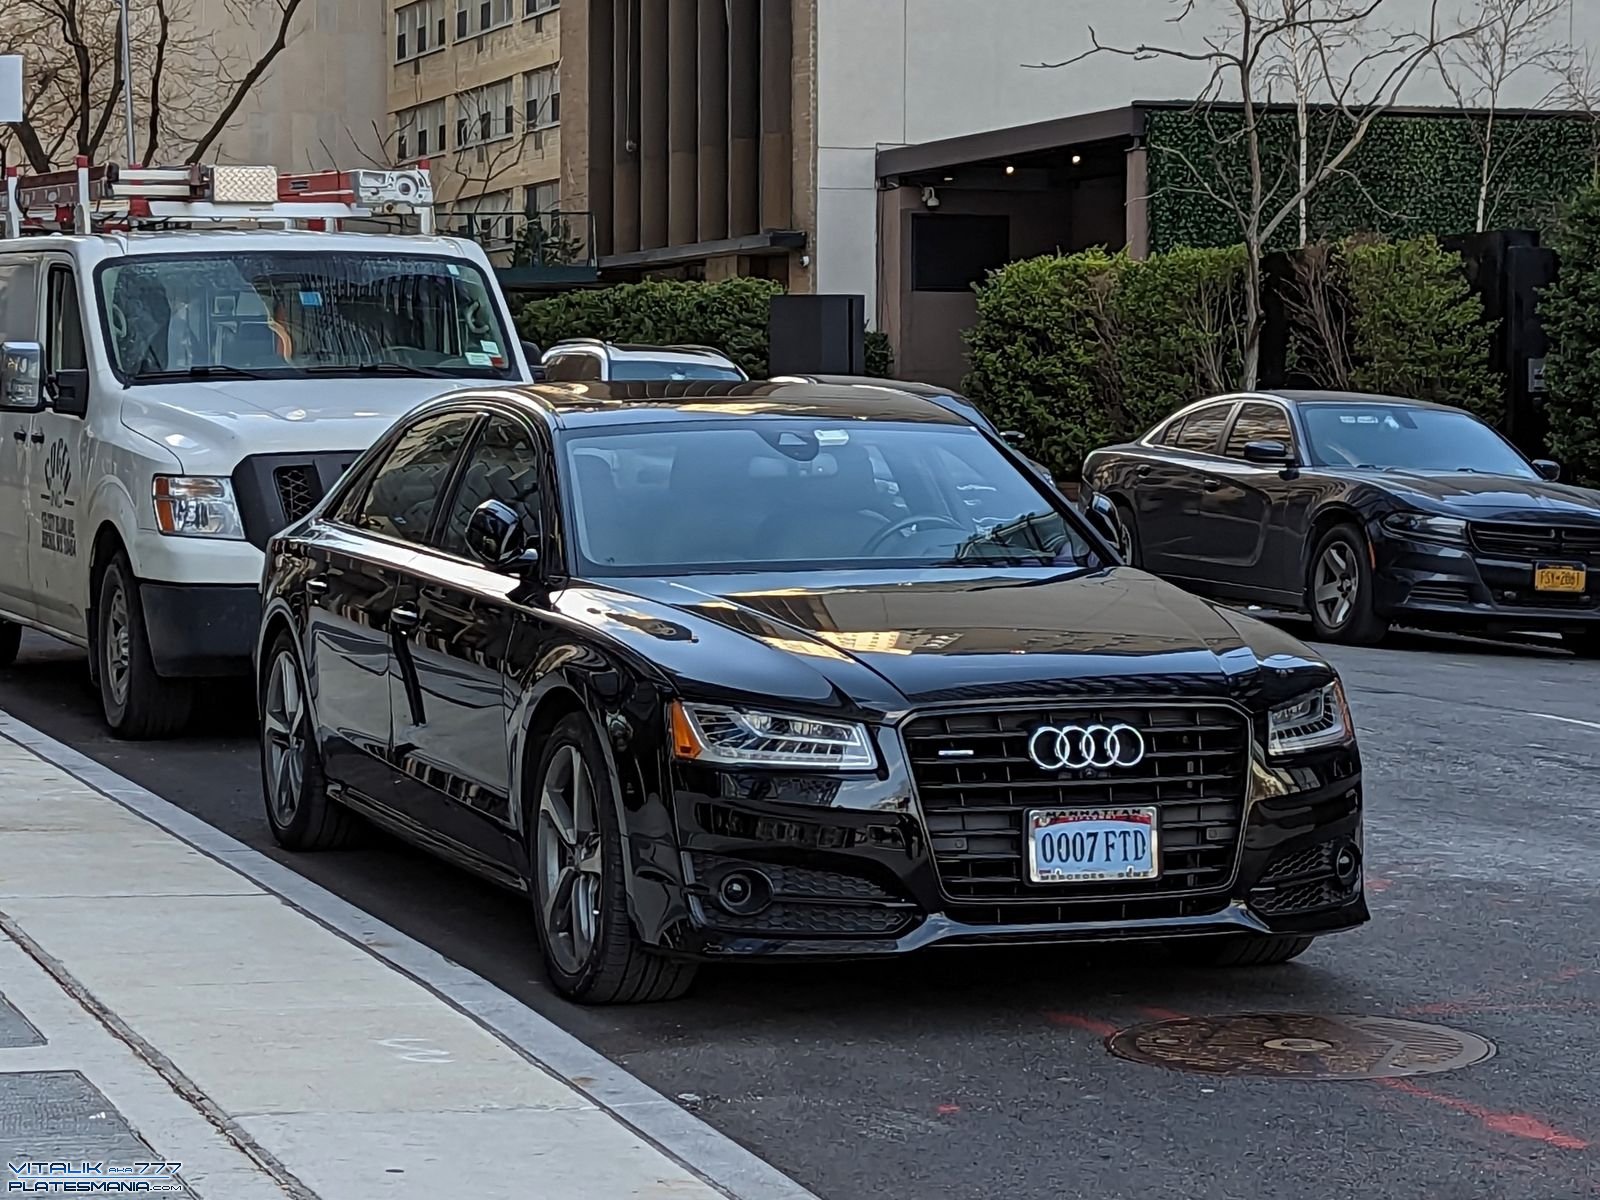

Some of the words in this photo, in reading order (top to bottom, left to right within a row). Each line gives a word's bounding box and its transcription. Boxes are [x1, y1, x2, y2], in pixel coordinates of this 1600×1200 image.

[1046, 809, 1141, 817] MANHATTAN
[1041, 832, 1099, 863] 0007
[1104, 830, 1147, 862] FTD
